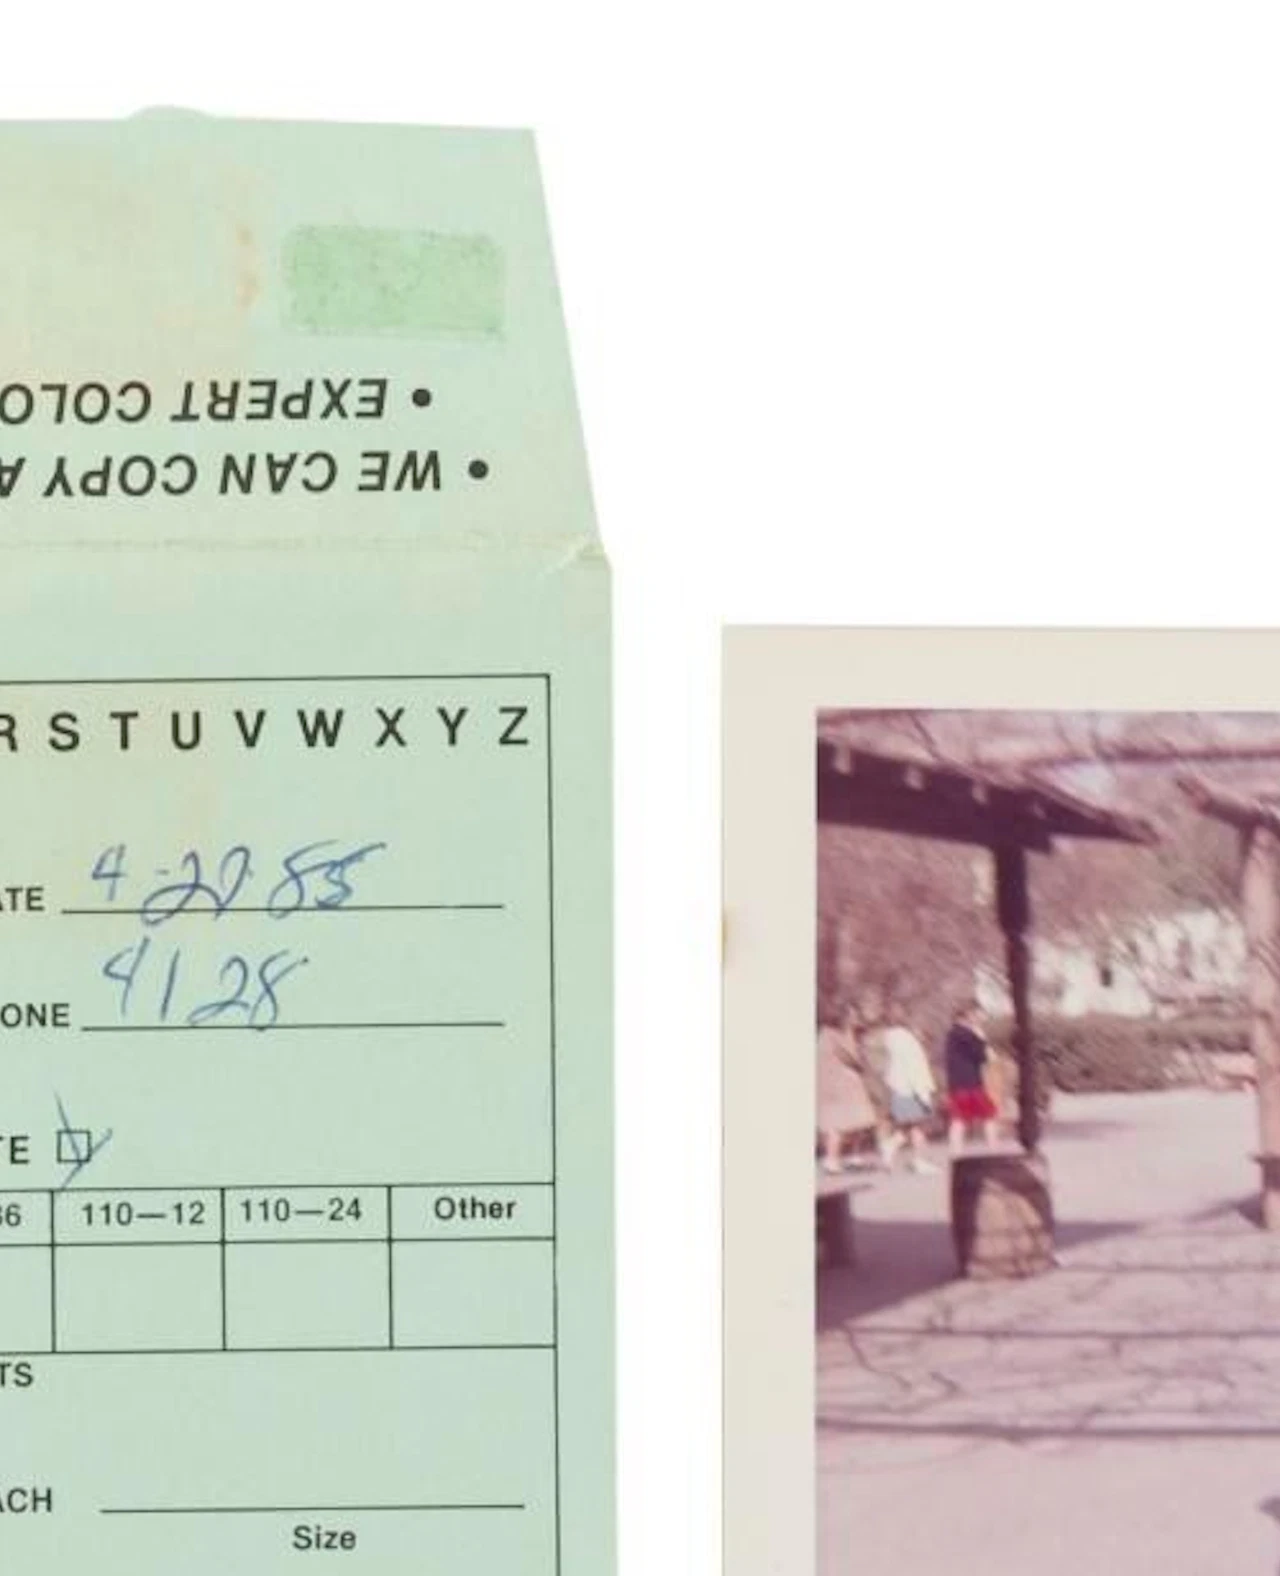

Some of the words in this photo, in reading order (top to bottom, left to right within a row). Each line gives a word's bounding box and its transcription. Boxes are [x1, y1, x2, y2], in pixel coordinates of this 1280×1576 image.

[169, 377, 388, 423] EXPERT
[41, 452, 198, 499] COPY
[218, 450, 338, 496] CAN
[356, 449, 442, 492] WE
[48, 710, 81, 753] S
[108, 710, 140, 751] T
[170, 710, 202, 752] U
[233, 708, 267, 749] V
[296, 708, 345, 749] W
[374, 706, 408, 748] X
[436, 706, 469, 747] Y
[498, 705, 530, 747] Z
[102, 938, 310, 1032] 4128
[433, 1195, 517, 1222] Other
[292, 1524, 357, 1552] Size
